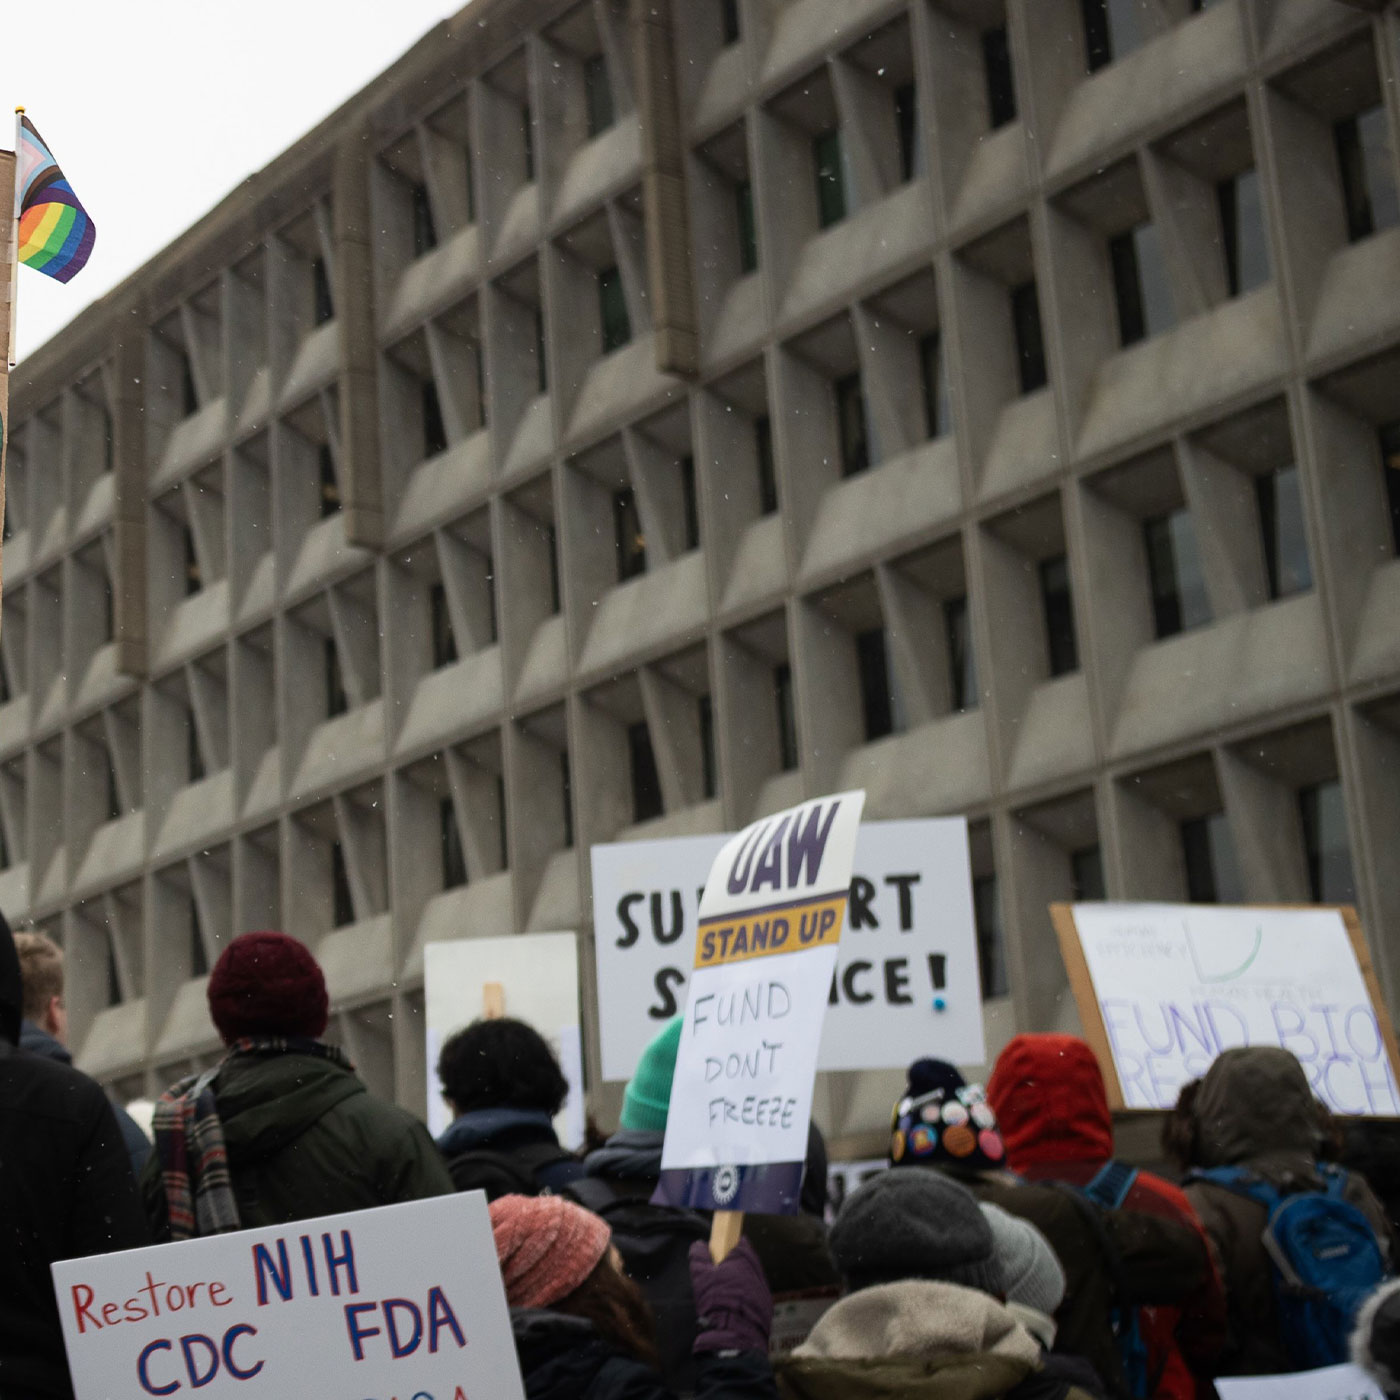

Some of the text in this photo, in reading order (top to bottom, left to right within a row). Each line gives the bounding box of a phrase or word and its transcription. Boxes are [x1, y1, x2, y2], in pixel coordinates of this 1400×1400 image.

[726, 800, 842, 896] UAW
[615, 874, 922, 949] SURT
[701, 908, 836, 961] STAND UP
[692, 982, 792, 1037] FUND
[1101, 998, 1384, 1063] FUND BIO
[704, 1040, 784, 1083] DON'T
[708, 1096, 797, 1130] FREEZE
[70, 1229, 360, 1333] Restore NIH
[136, 1285, 468, 1396] CDC FDA
